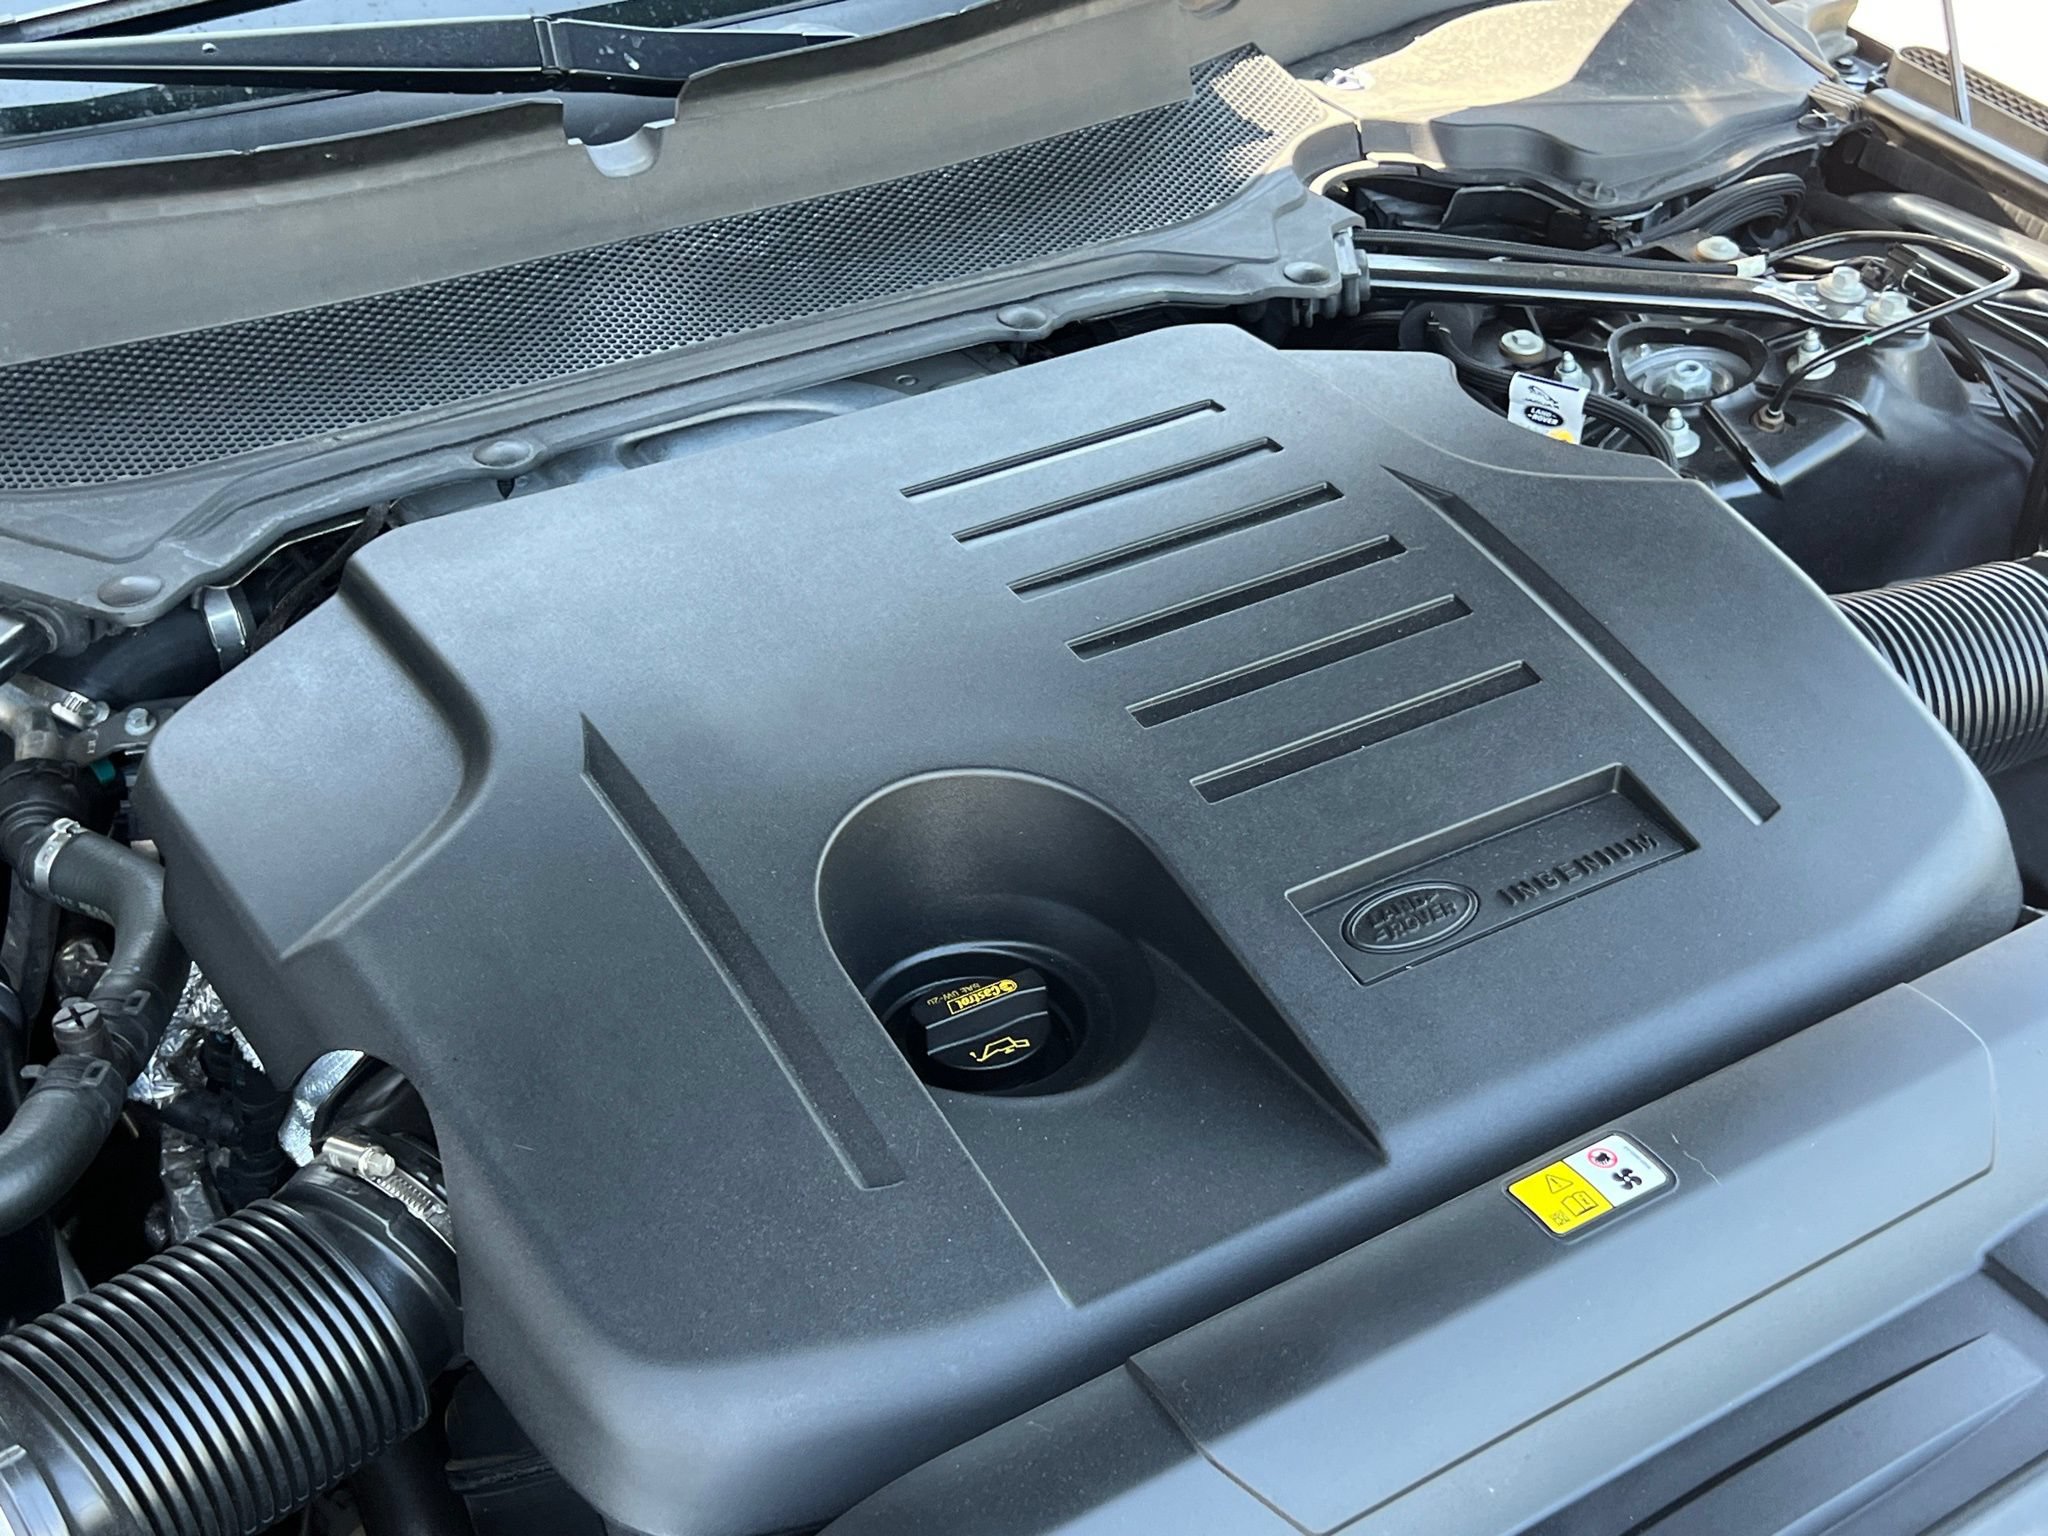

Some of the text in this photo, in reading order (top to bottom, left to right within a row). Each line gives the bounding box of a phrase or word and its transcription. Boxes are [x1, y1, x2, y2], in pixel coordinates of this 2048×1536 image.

[1496, 832, 1661, 906] INGENIUM
[1367, 891, 1431, 927] LAND
[1387, 900, 1458, 942] ROVER
[955, 985, 1001, 1010] Castrol
